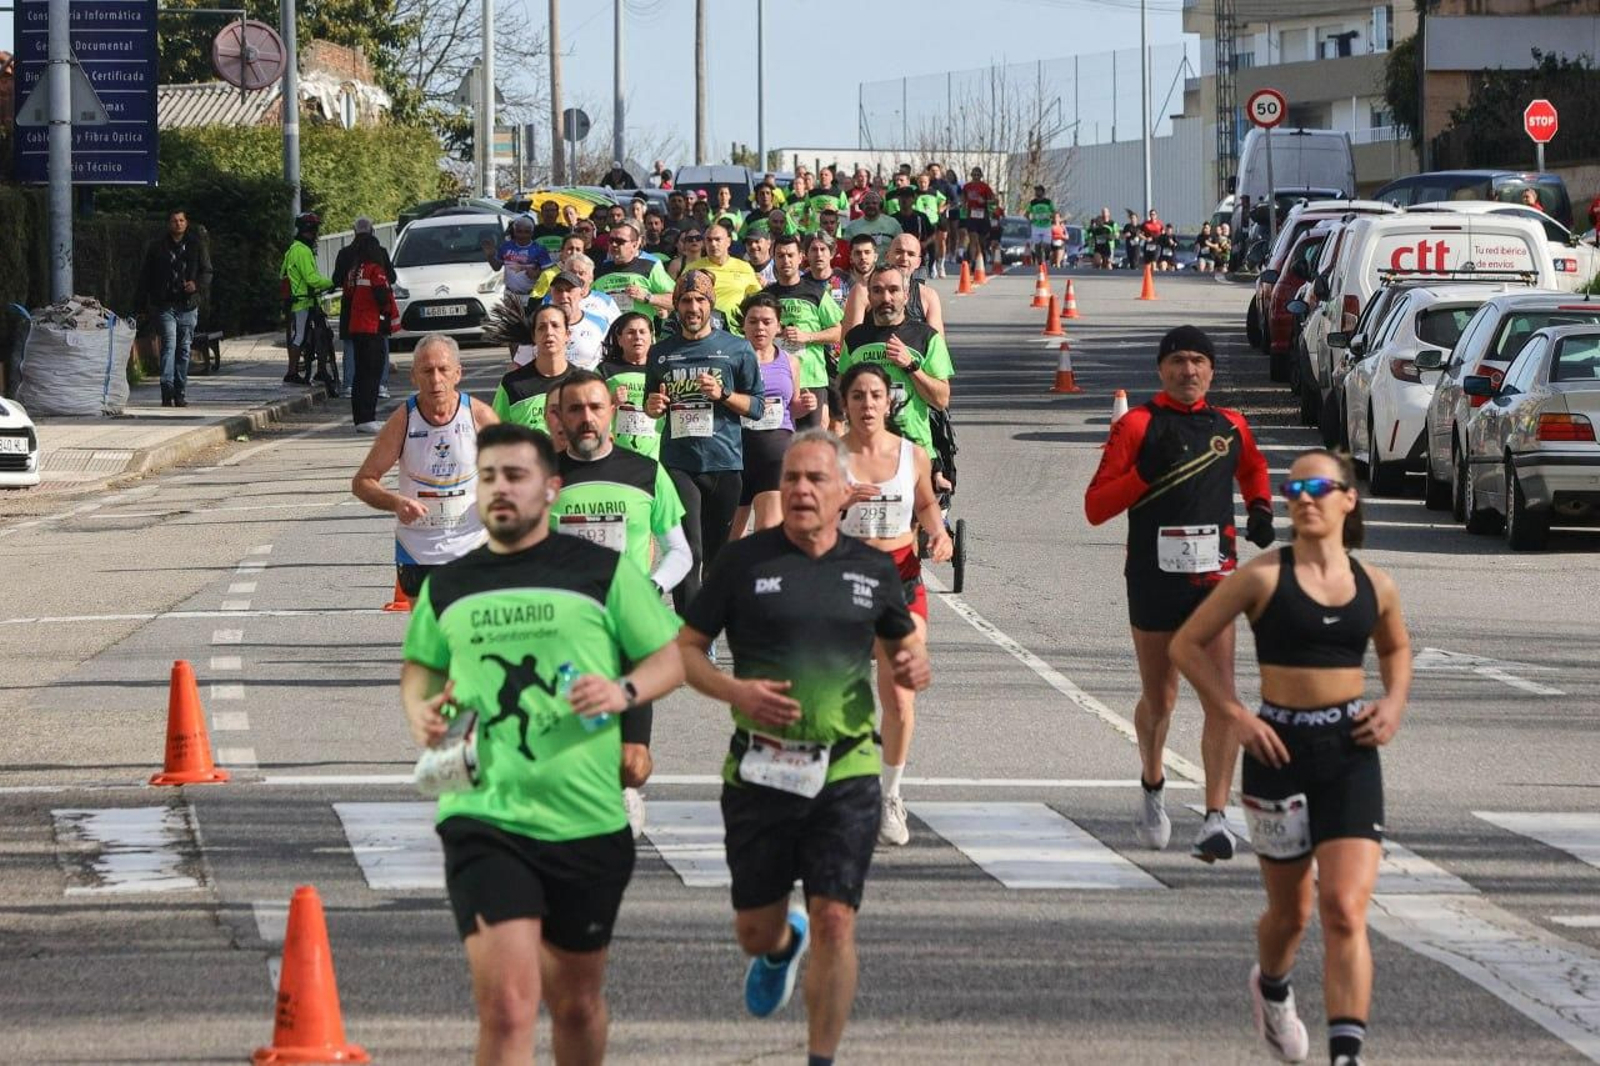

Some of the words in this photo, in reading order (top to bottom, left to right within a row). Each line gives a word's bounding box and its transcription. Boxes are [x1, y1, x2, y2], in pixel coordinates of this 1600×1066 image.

[84, 10, 141, 21] Informática
[75, 41, 133, 51] Documental
[91, 71, 144, 81] Certificada
[1257, 102, 1277, 115] 50
[1529, 115, 1555, 127] STOP
[76, 134, 82, 144] y
[85, 131, 109, 142] Fibra
[86, 161, 122, 172] Técnico
[1475, 245, 1485, 255] Tu
[1486, 246, 1499, 255] red
[1391, 239, 1450, 276] ctt
[1476, 260, 1487, 268] de
[673, 367, 687, 381] NO
[680, 413, 700, 424] 596
[565, 501, 627, 515] CALVARIO
[860, 507, 886, 521] 295
[1181, 541, 1198, 556] 21
[755, 577, 782, 593] DK
[470, 603, 555, 629] CALVARIO
[1294, 707, 1341, 726] PRO
